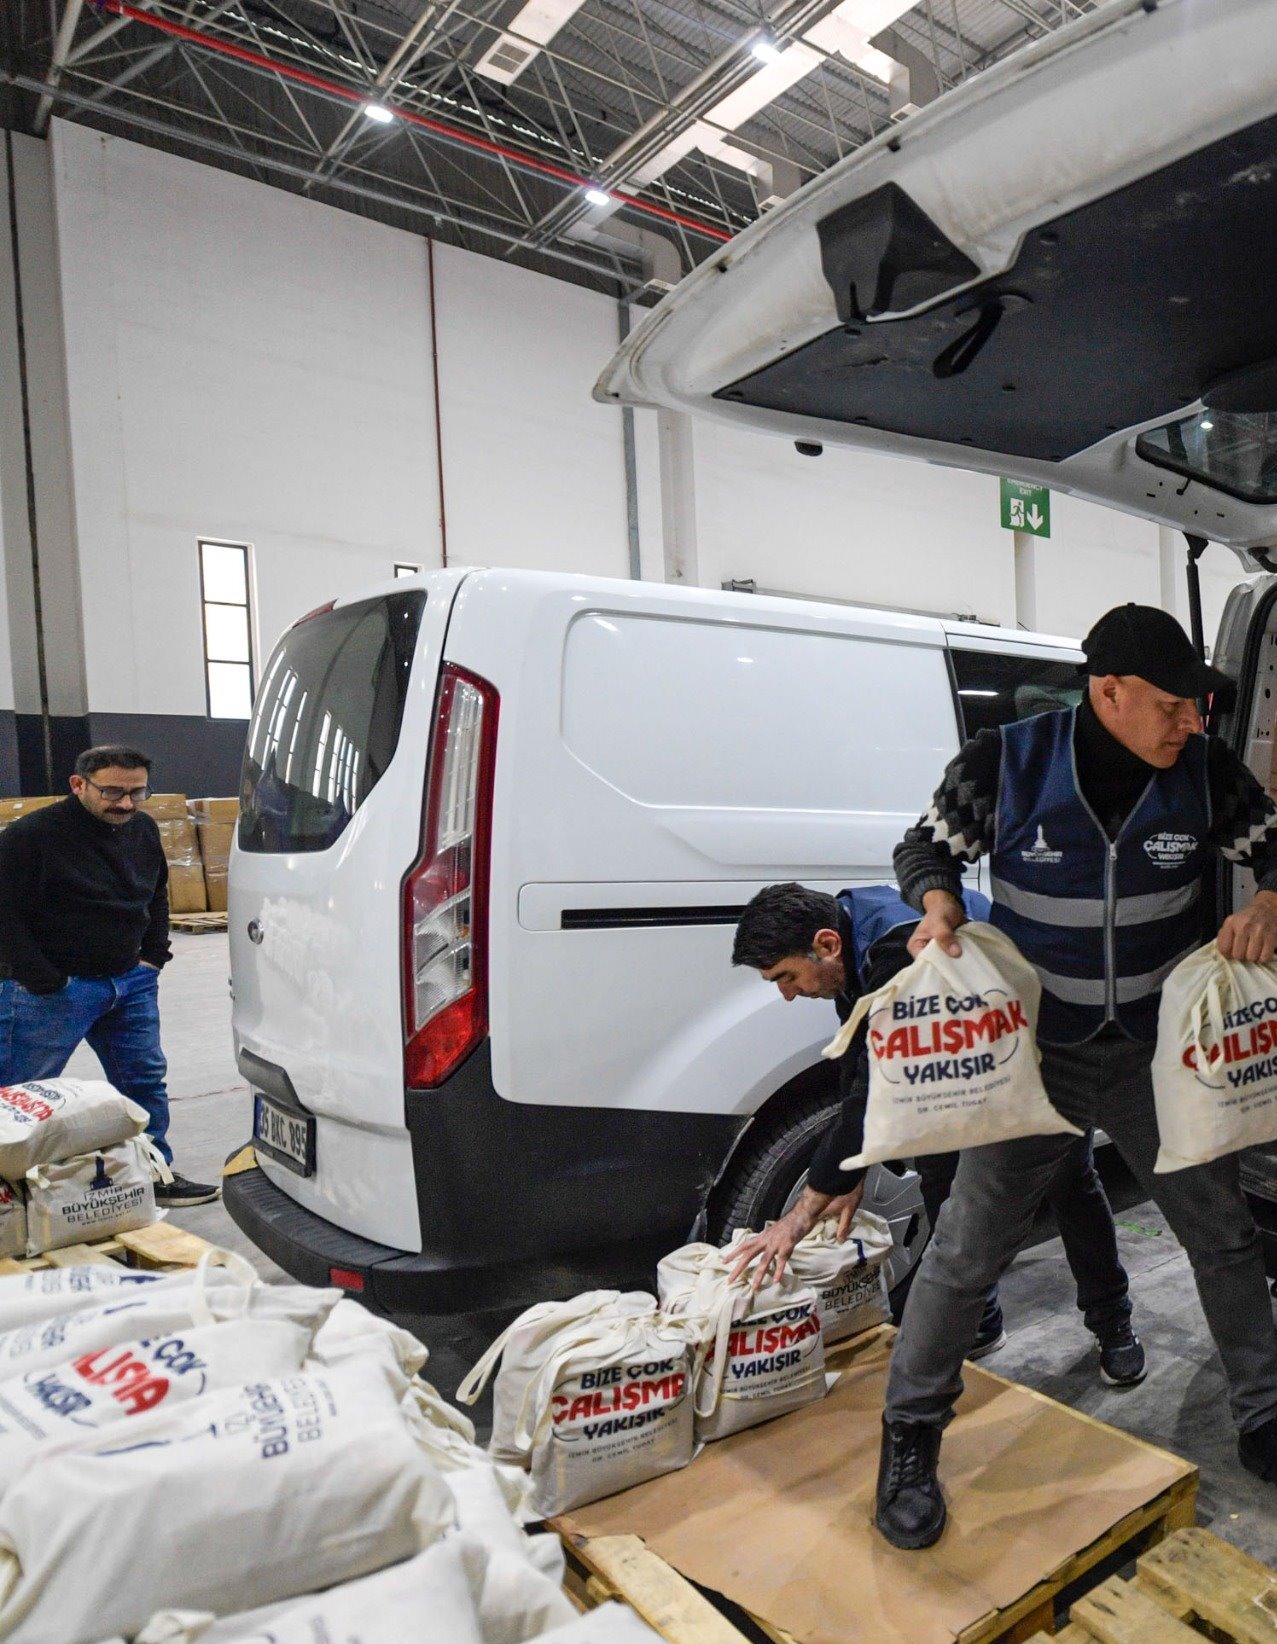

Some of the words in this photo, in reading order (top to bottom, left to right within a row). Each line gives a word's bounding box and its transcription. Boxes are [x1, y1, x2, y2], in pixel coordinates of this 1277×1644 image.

[893, 995, 940, 1020] BİZE
[871, 1000, 1029, 1060] ÇALIŞMAK
[904, 1053, 996, 1085] YAKIŞIR
[62, 1187, 145, 1215] BÜYÜKŞEHİR
[84, 1186, 122, 1201] İZMİR
[67, 1198, 143, 1223] BELEDİYESİ
[626, 1358, 674, 1379] ÇOK
[732, 1350, 801, 1379] YAKIŞIR
[583, 1407, 665, 1440] YAKIŞIR
